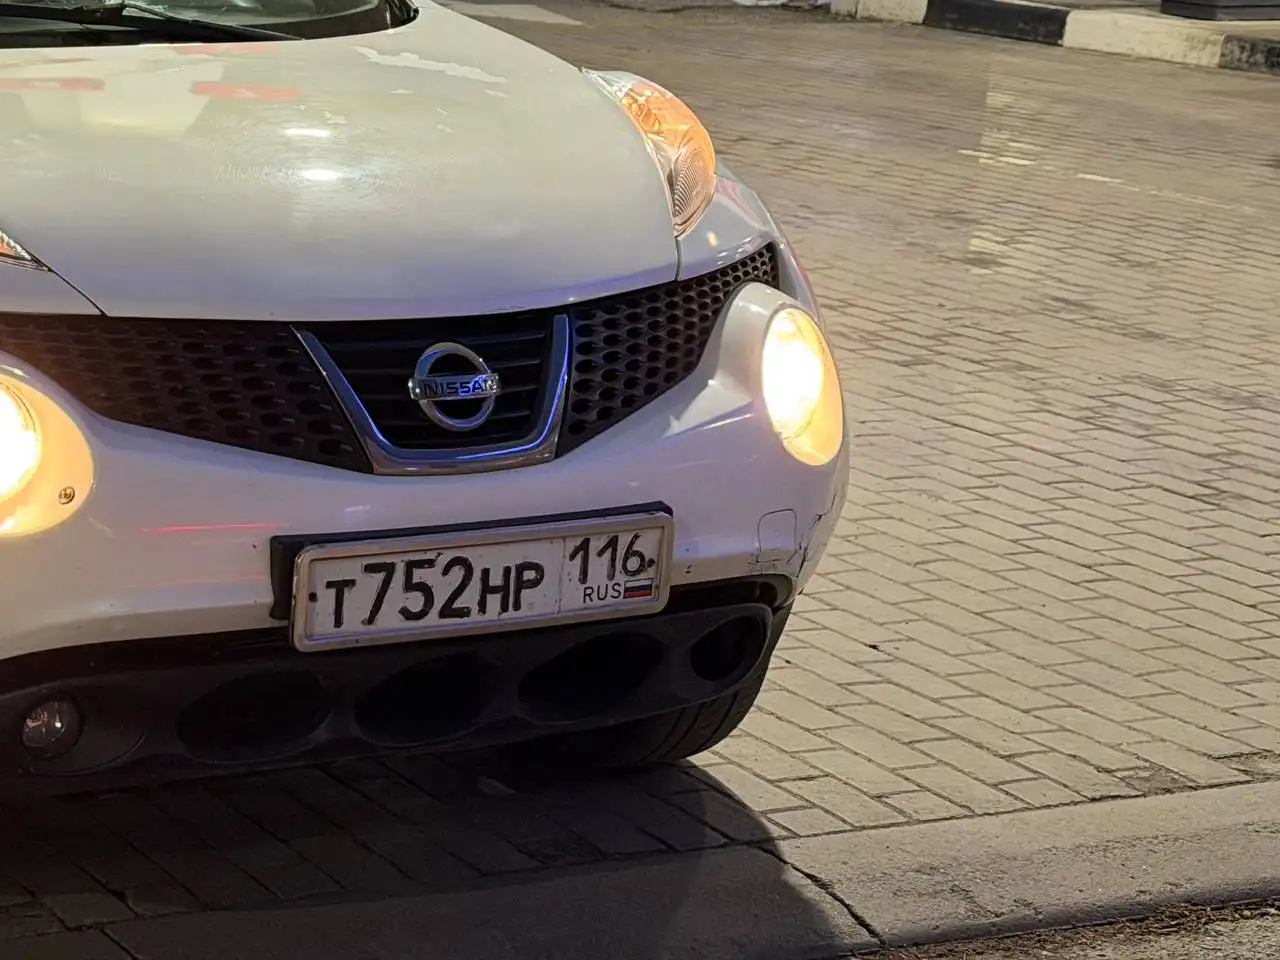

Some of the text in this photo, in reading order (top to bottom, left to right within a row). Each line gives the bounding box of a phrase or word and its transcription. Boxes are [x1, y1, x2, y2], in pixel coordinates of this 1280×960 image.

[423, 378, 497, 397] NISSAN
[568, 532, 648, 586] 116
[582, 583, 622, 605] RUS
